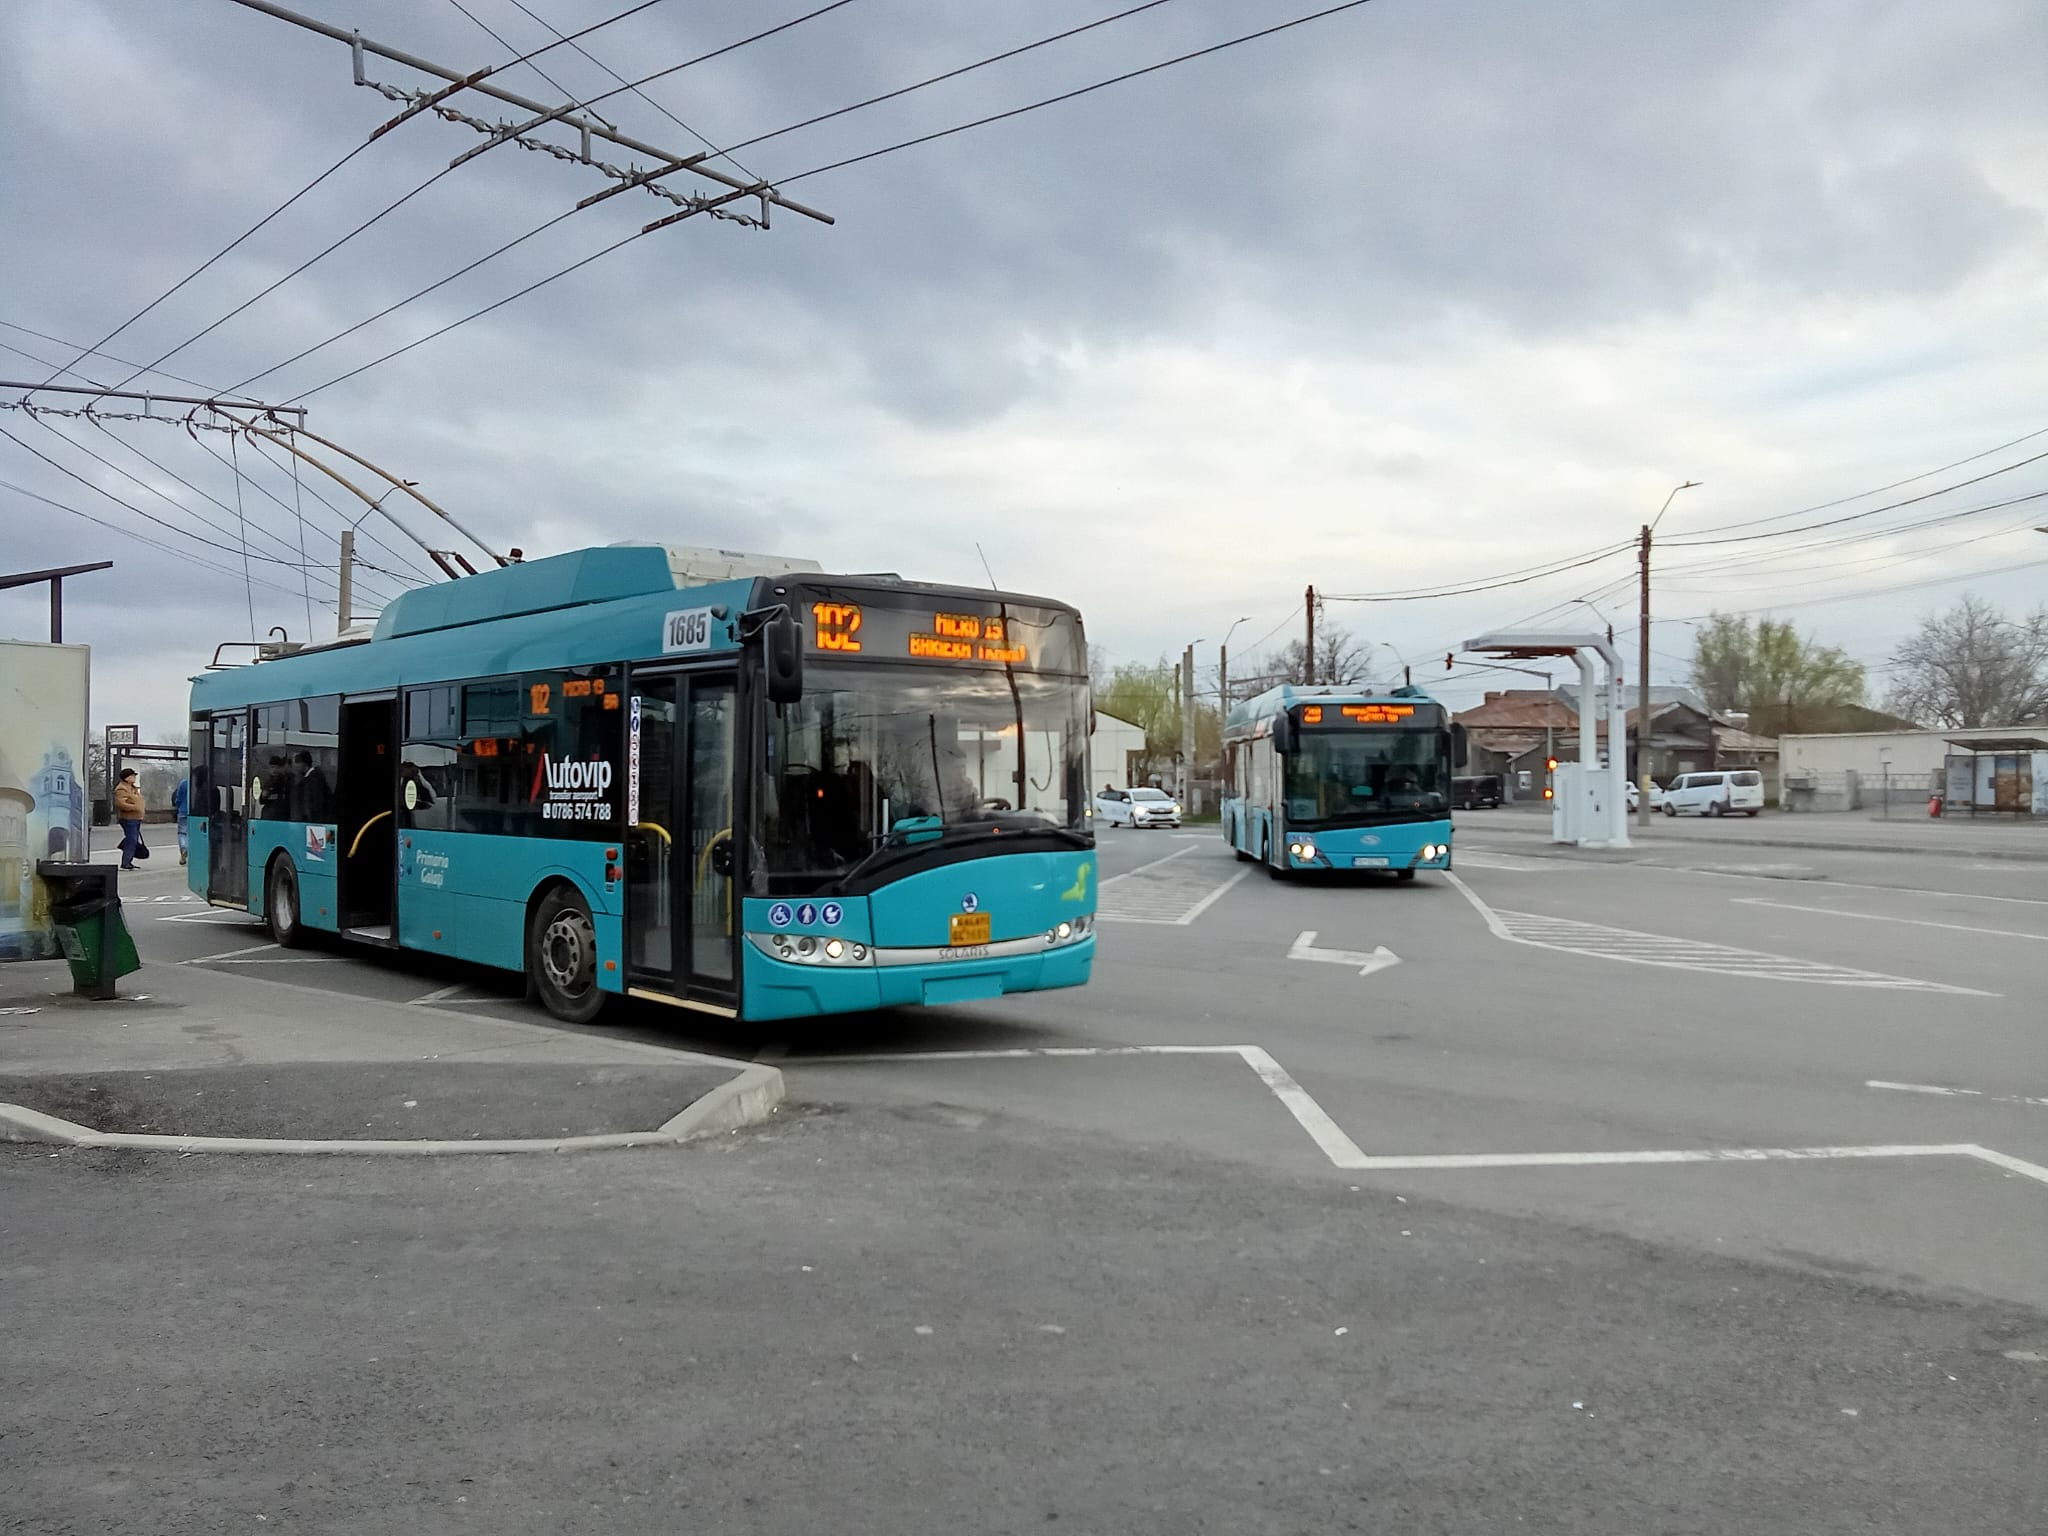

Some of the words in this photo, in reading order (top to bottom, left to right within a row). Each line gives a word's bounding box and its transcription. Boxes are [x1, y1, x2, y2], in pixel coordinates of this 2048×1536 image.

[669, 612, 706, 646] 1685
[812, 602, 861, 651] 102
[530, 747, 611, 800] Autovip
[552, 803, 573, 819] 0786
[575, 803, 591, 819] 574
[593, 803, 611, 820] 788
[939, 946, 989, 960] SOLARIS
